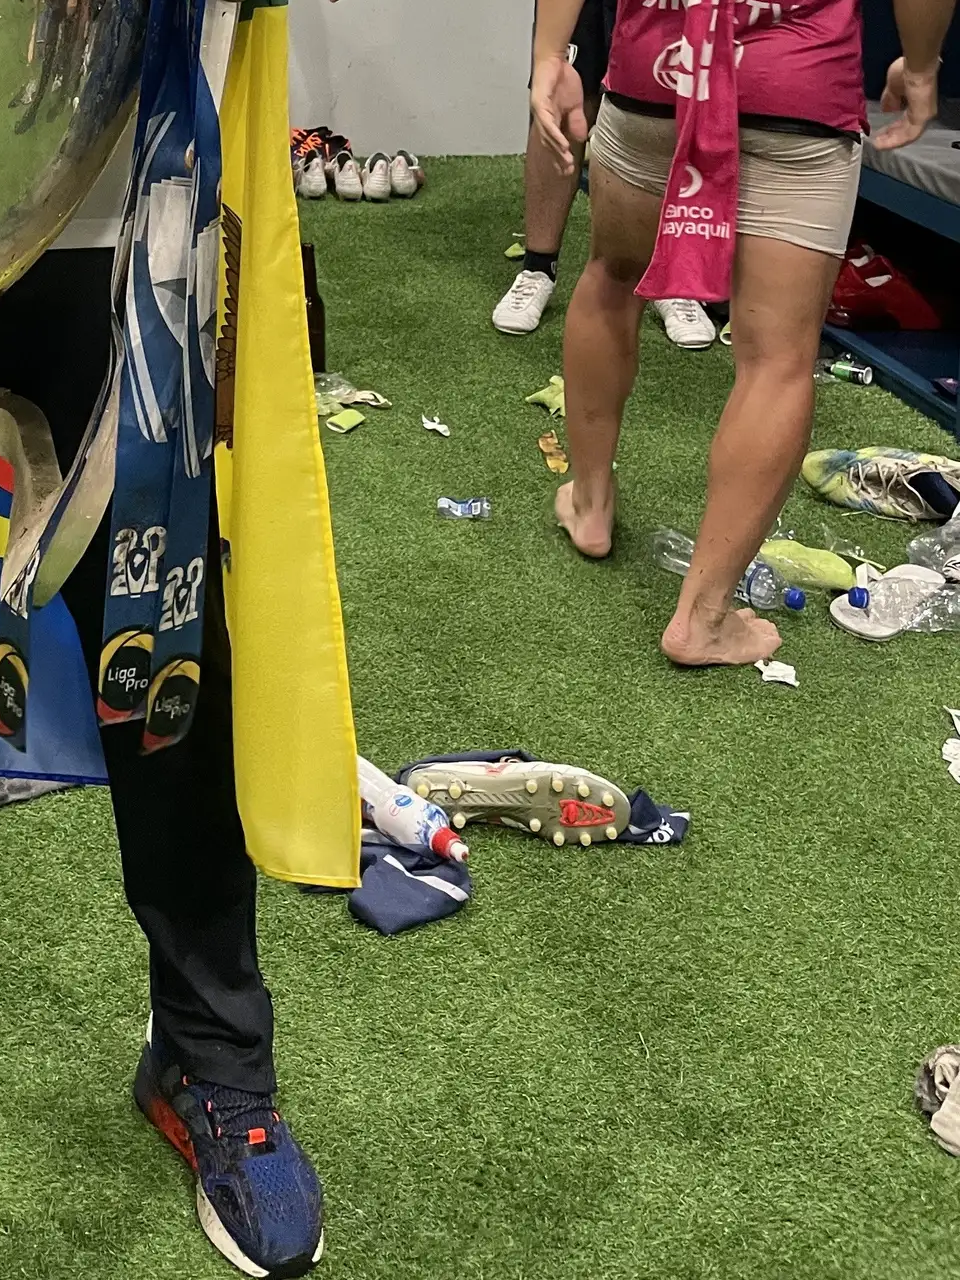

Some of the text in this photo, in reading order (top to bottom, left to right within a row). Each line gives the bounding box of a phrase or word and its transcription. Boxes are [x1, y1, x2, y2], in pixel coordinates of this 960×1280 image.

[665, 204, 714, 220] anco
[107, 667, 137, 683] Liga
[126, 678, 149, 692] Pro
